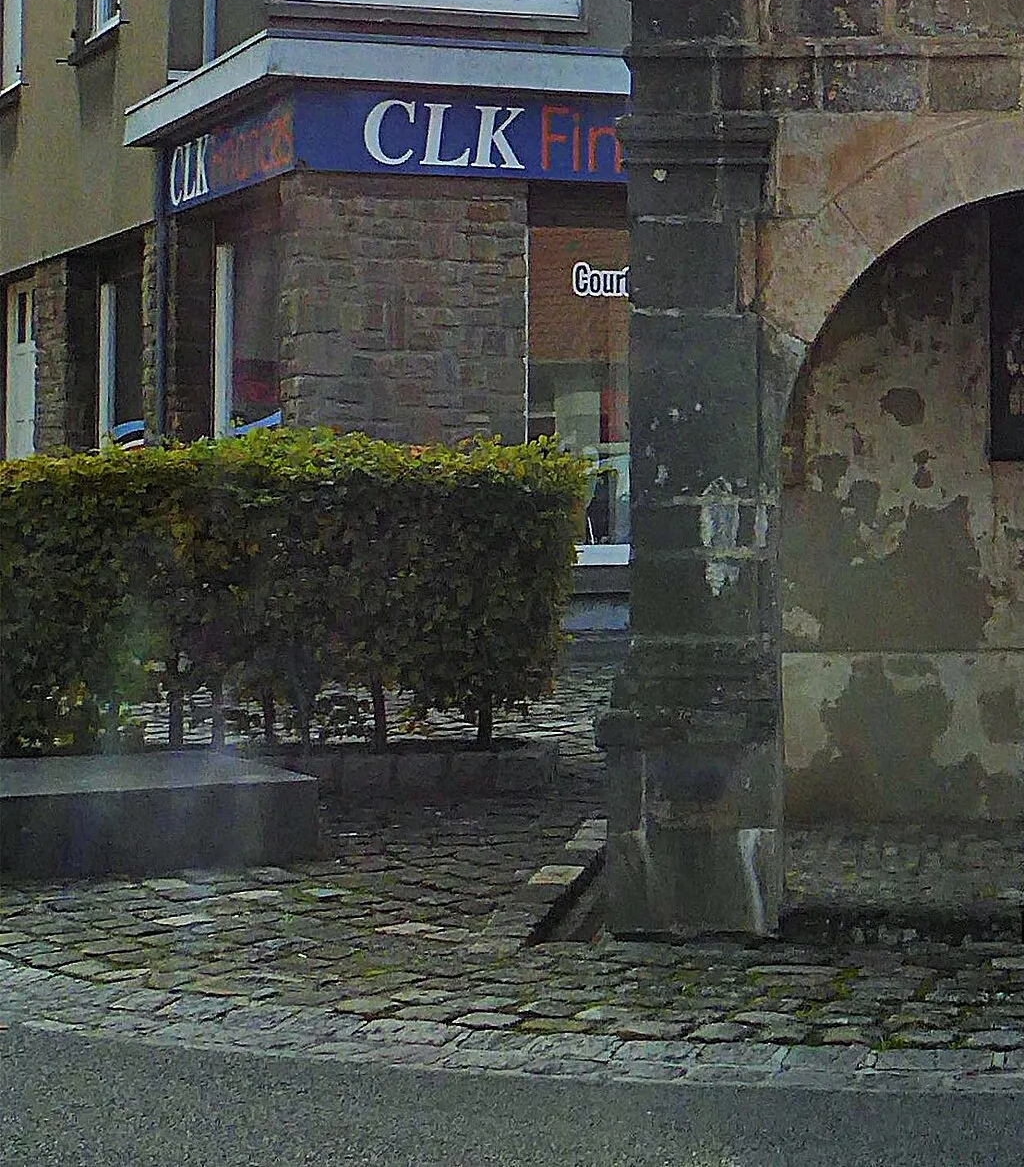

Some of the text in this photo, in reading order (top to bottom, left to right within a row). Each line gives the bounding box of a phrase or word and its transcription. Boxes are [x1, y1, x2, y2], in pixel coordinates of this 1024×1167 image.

[169, 133, 209, 206] CLK
[364, 99, 623, 173] CLK Fin
